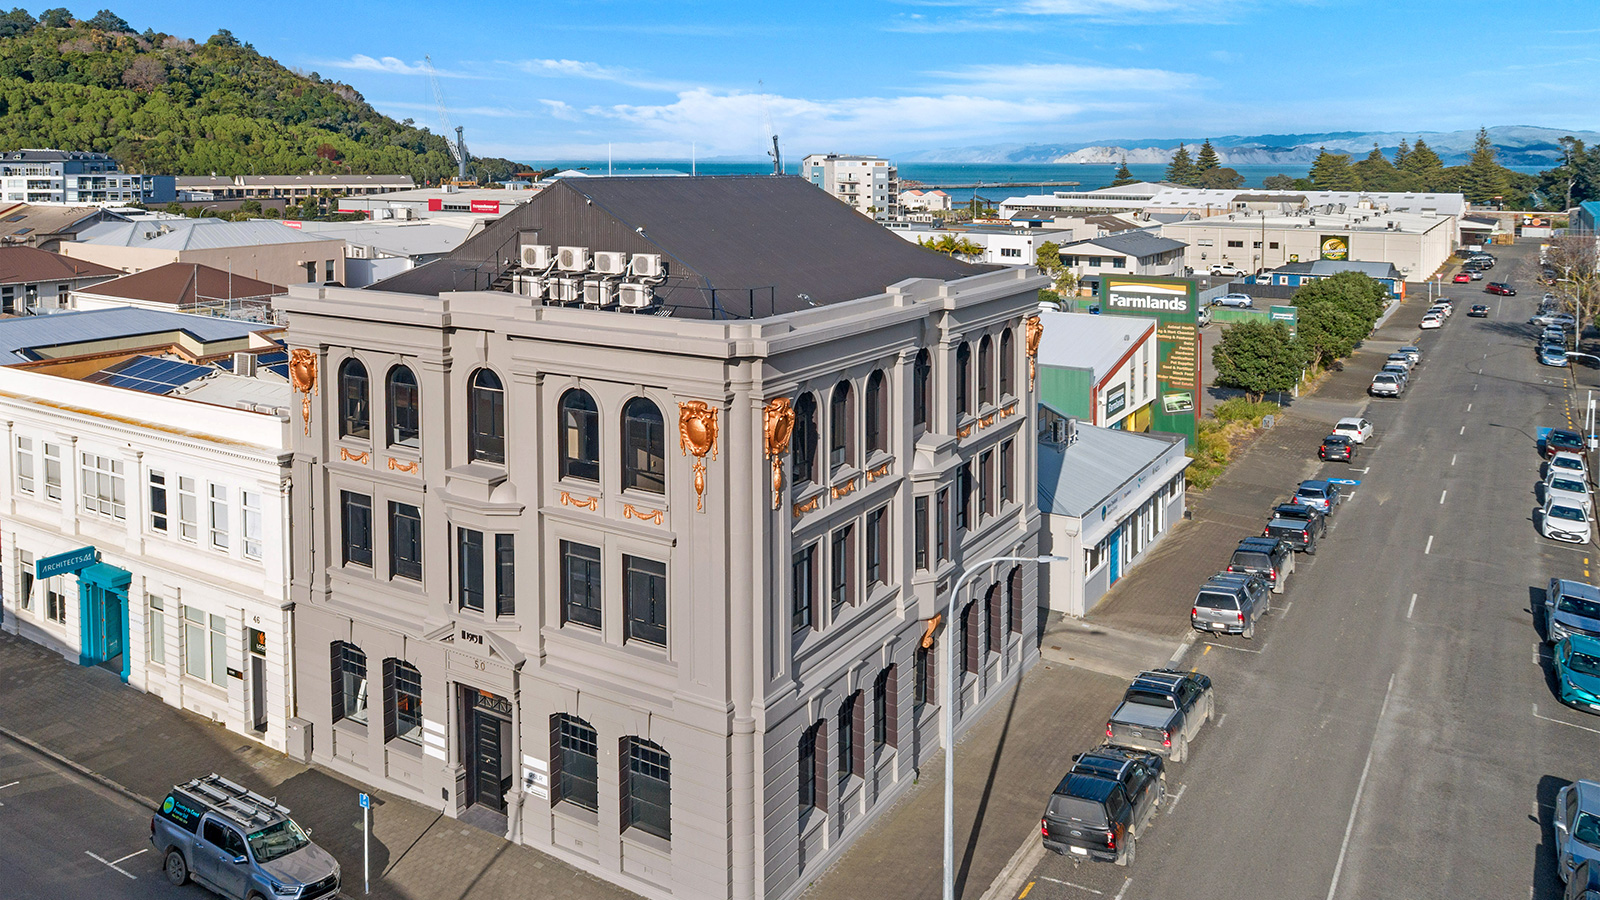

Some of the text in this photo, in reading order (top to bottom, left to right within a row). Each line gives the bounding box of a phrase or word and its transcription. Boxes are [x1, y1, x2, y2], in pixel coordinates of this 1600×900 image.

[1109, 294, 1187, 311] Farmlands
[42, 555, 83, 573] ARCHITECTS
[253, 615, 261, 624] 46
[474, 660, 485, 671] 50
